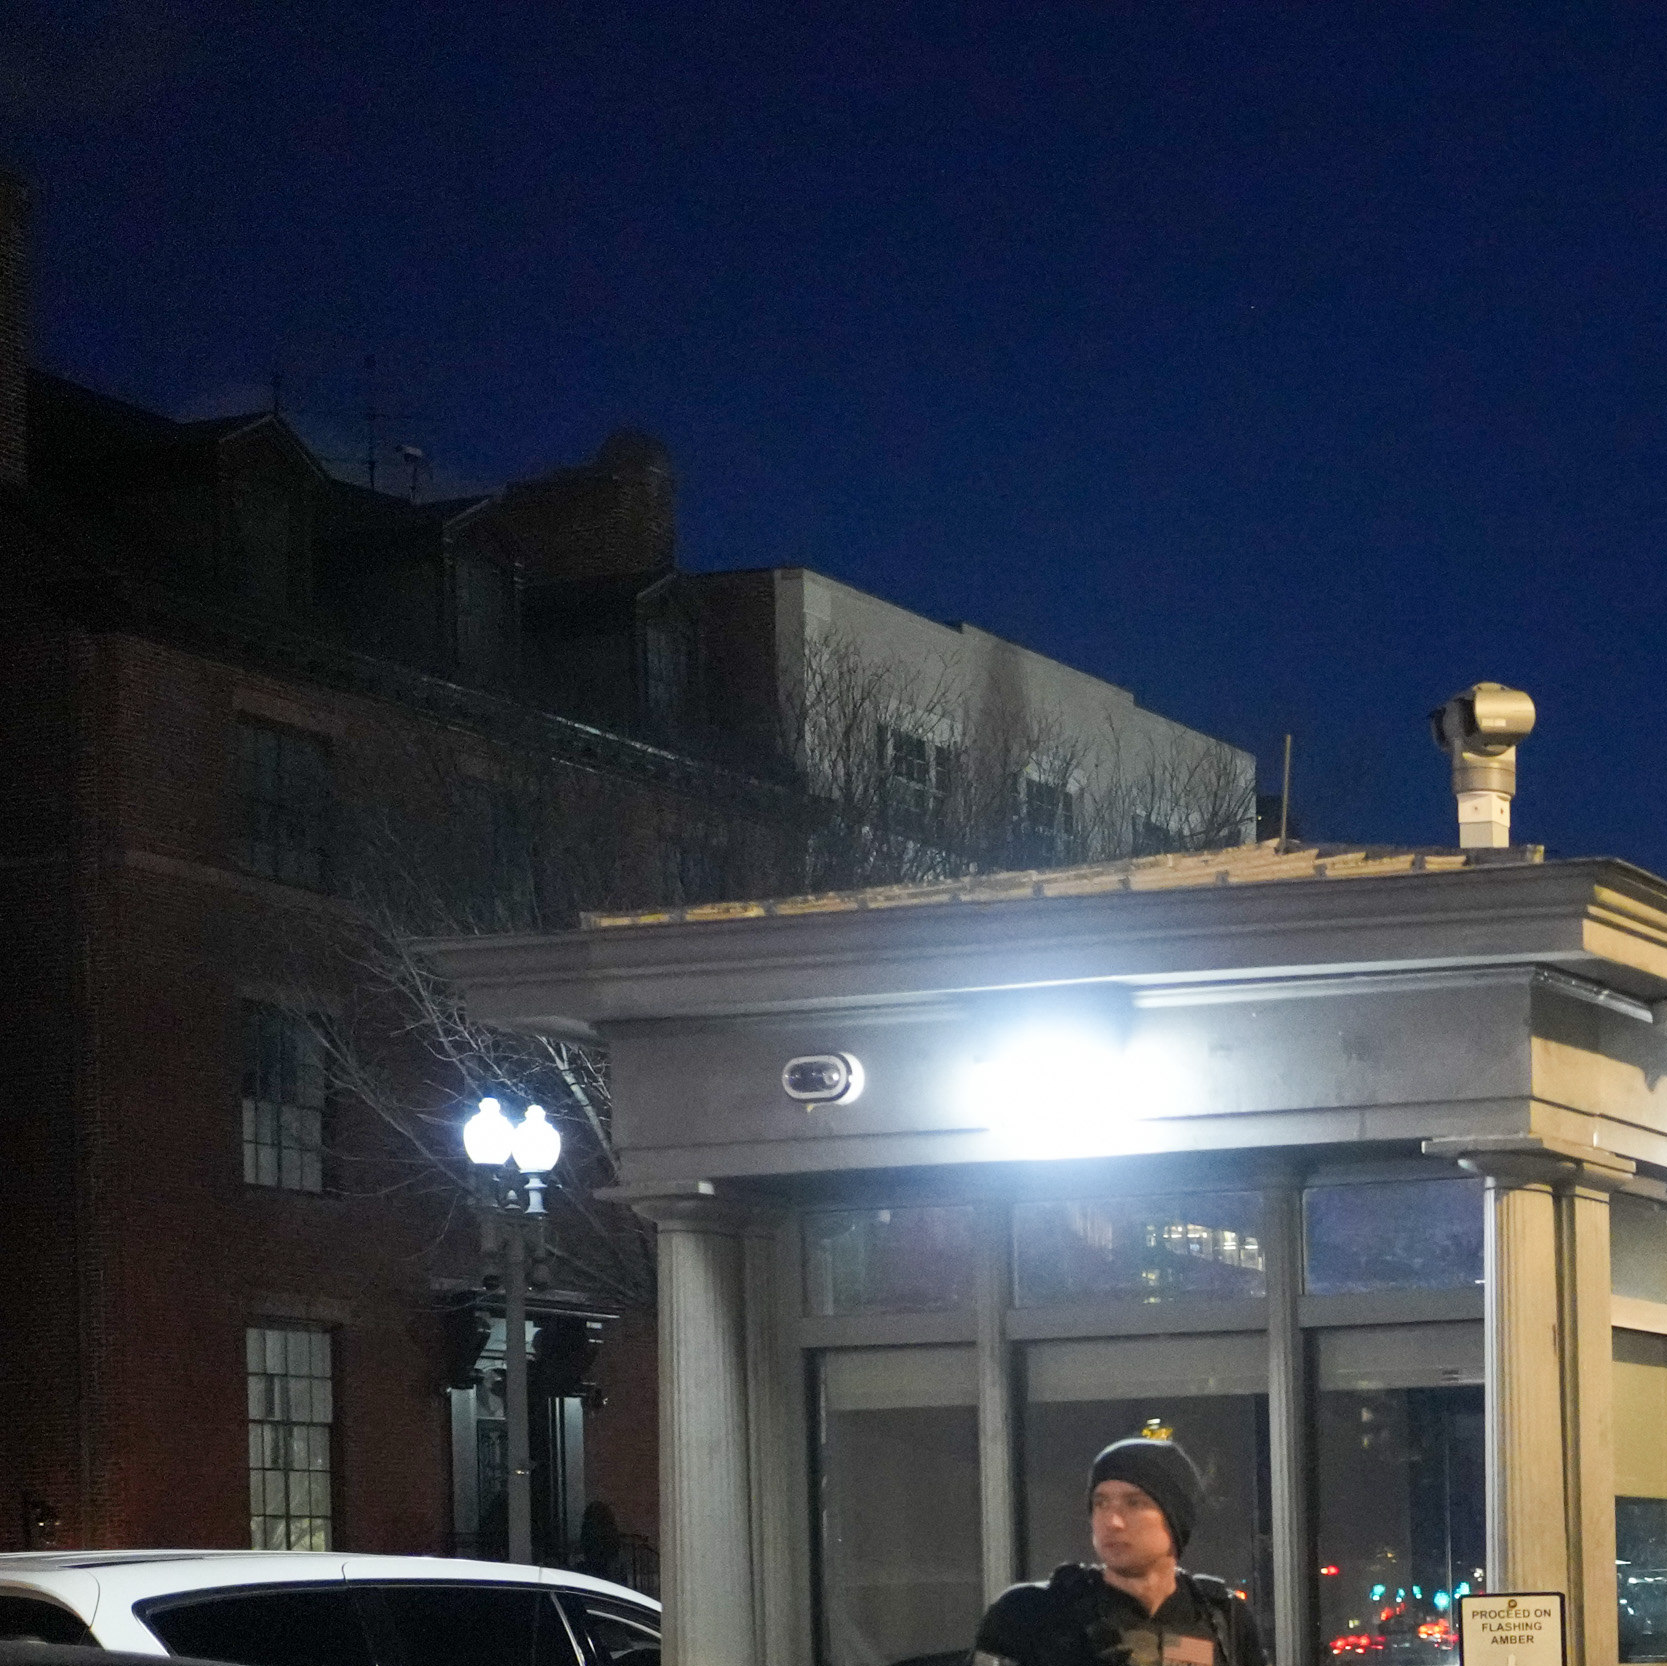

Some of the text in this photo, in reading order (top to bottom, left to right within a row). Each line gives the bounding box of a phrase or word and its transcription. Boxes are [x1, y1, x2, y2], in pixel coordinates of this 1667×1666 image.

[1472, 1608, 1551, 1619] PROCEED ON
[1481, 1621, 1542, 1632] FLASHING
[1490, 1635, 1534, 1645] AMBER
